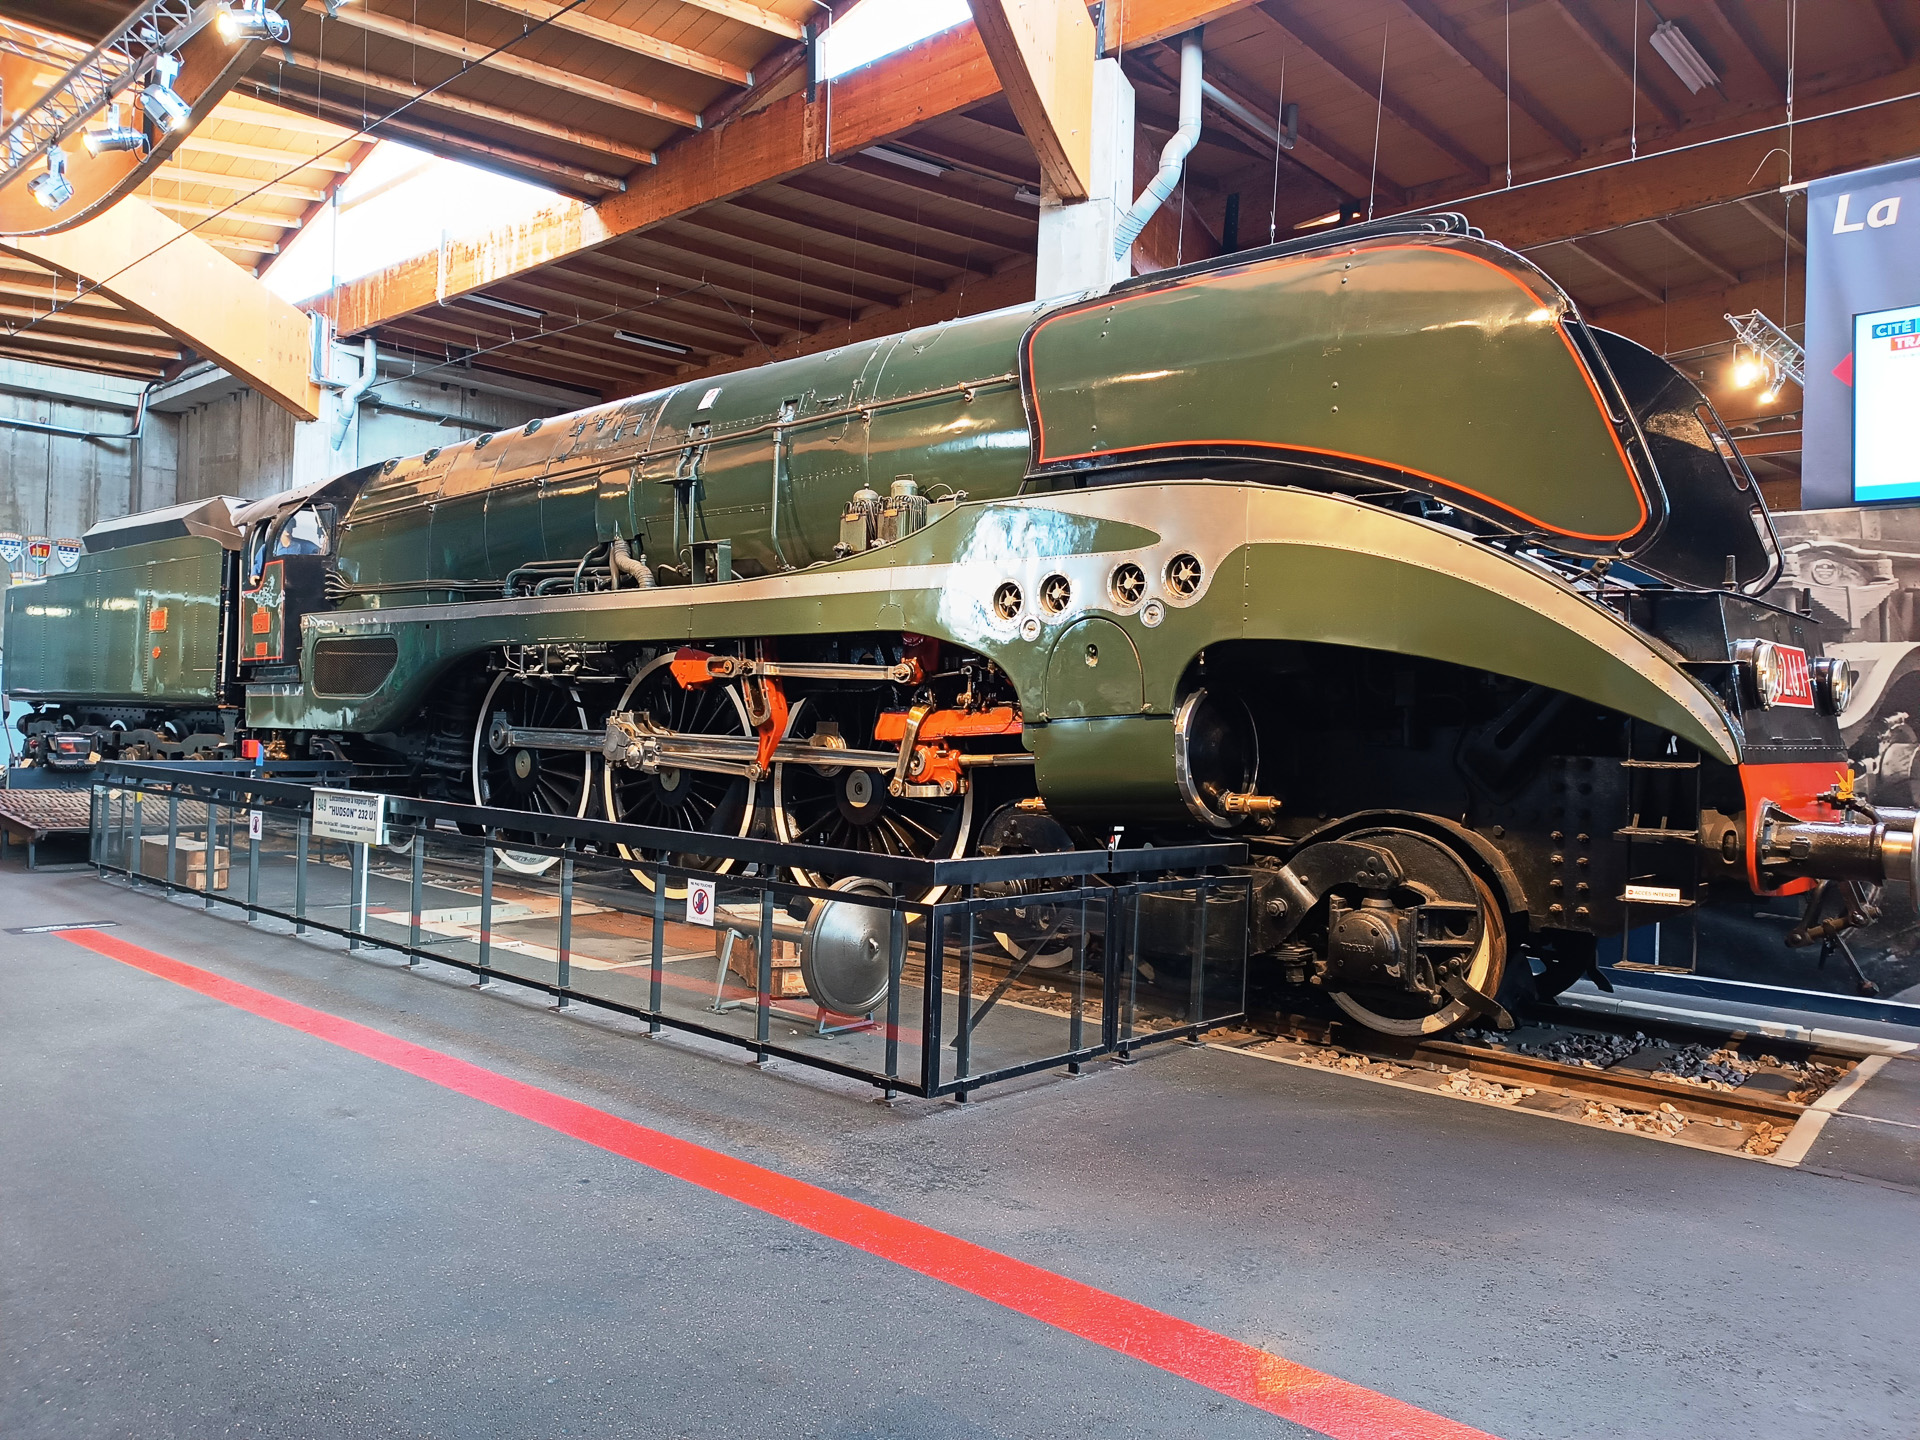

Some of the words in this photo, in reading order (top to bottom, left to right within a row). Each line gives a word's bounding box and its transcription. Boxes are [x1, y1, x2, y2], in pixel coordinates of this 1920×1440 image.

[1832, 193, 1901, 235] La
[1876, 320, 1912, 336] CITÉ
[315, 797, 327, 811] 1949
[329, 794, 350, 804] Locomotive
[354, 798, 368, 807] vapeur
[329, 805, 357, 818] "HUDSON"
[357, 809, 368, 820] 232
[368, 810, 377, 822] U1
